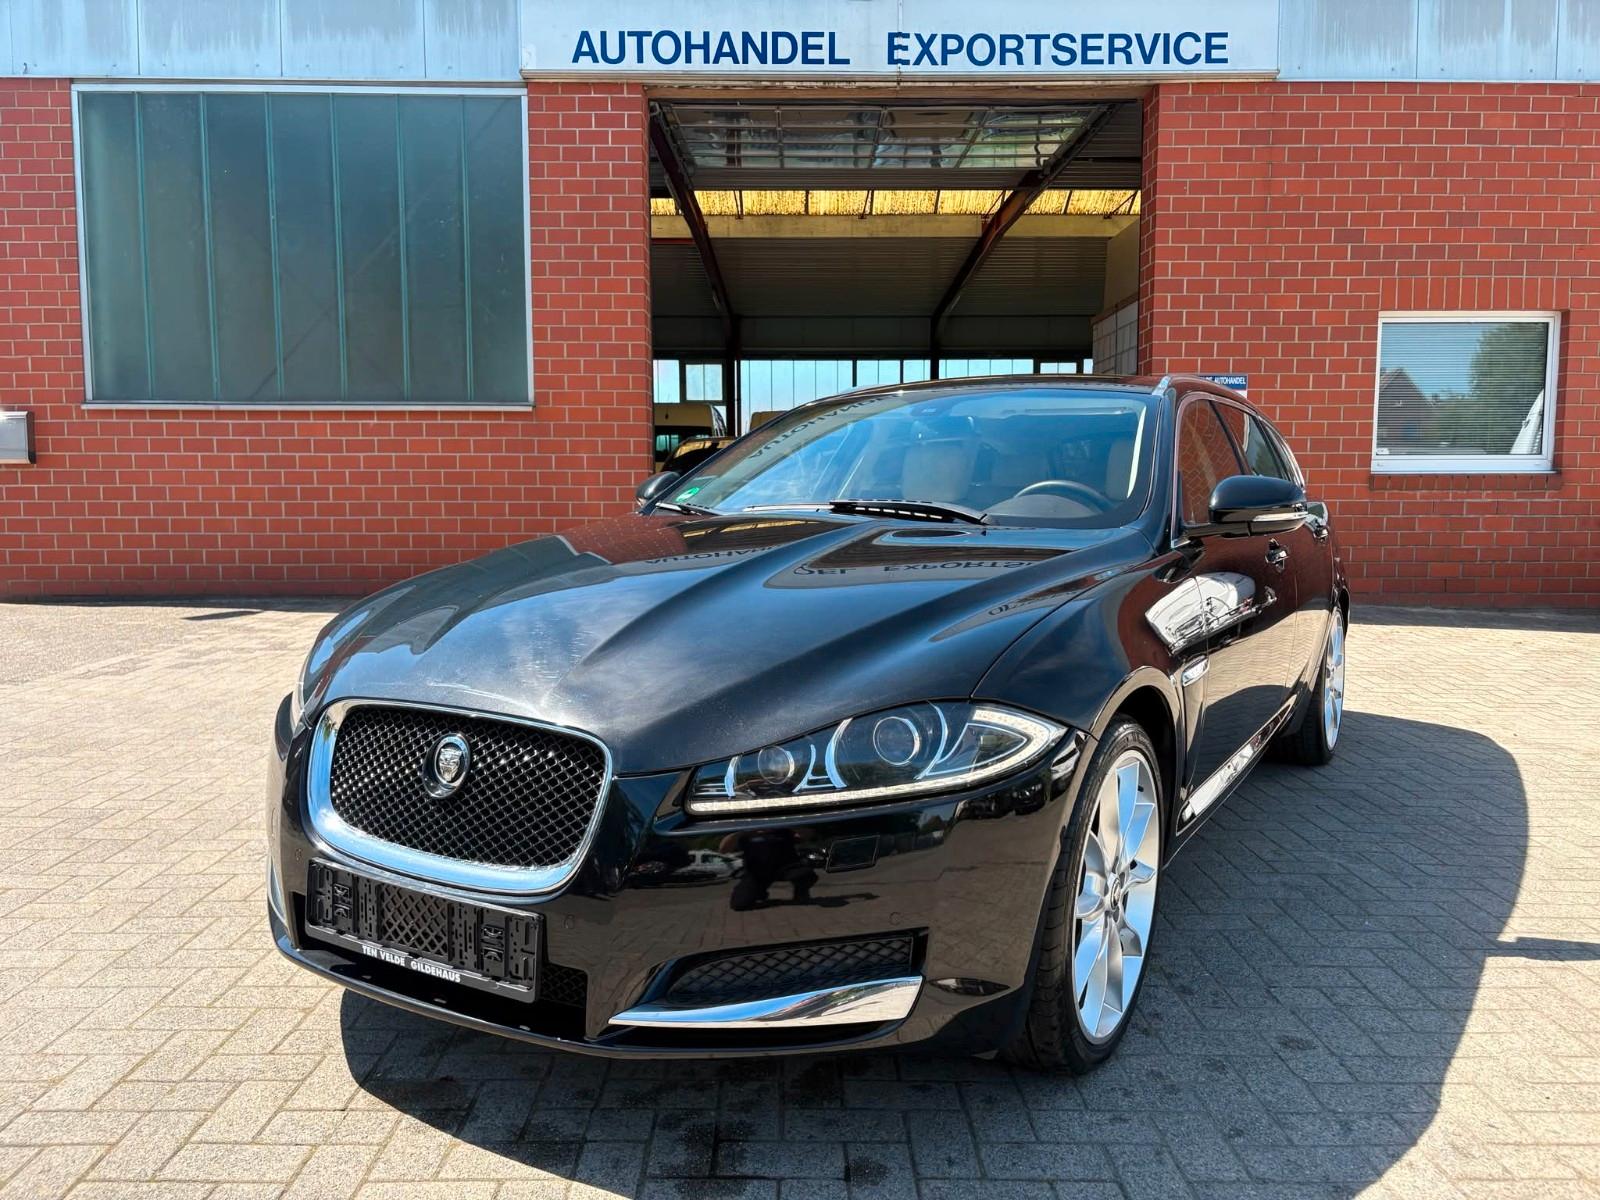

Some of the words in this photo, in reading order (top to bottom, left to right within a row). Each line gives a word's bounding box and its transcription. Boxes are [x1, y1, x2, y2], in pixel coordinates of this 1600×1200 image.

[572, 30, 850, 65] AUTOHANDEL
[887, 31, 1229, 66] EXPORTSERVICE
[1214, 376, 1246, 385] AUTOHANDEL
[361, 944, 378, 959] TEN
[379, 950, 406, 967] VELDE
[410, 960, 461, 983] GILDEHAUS
